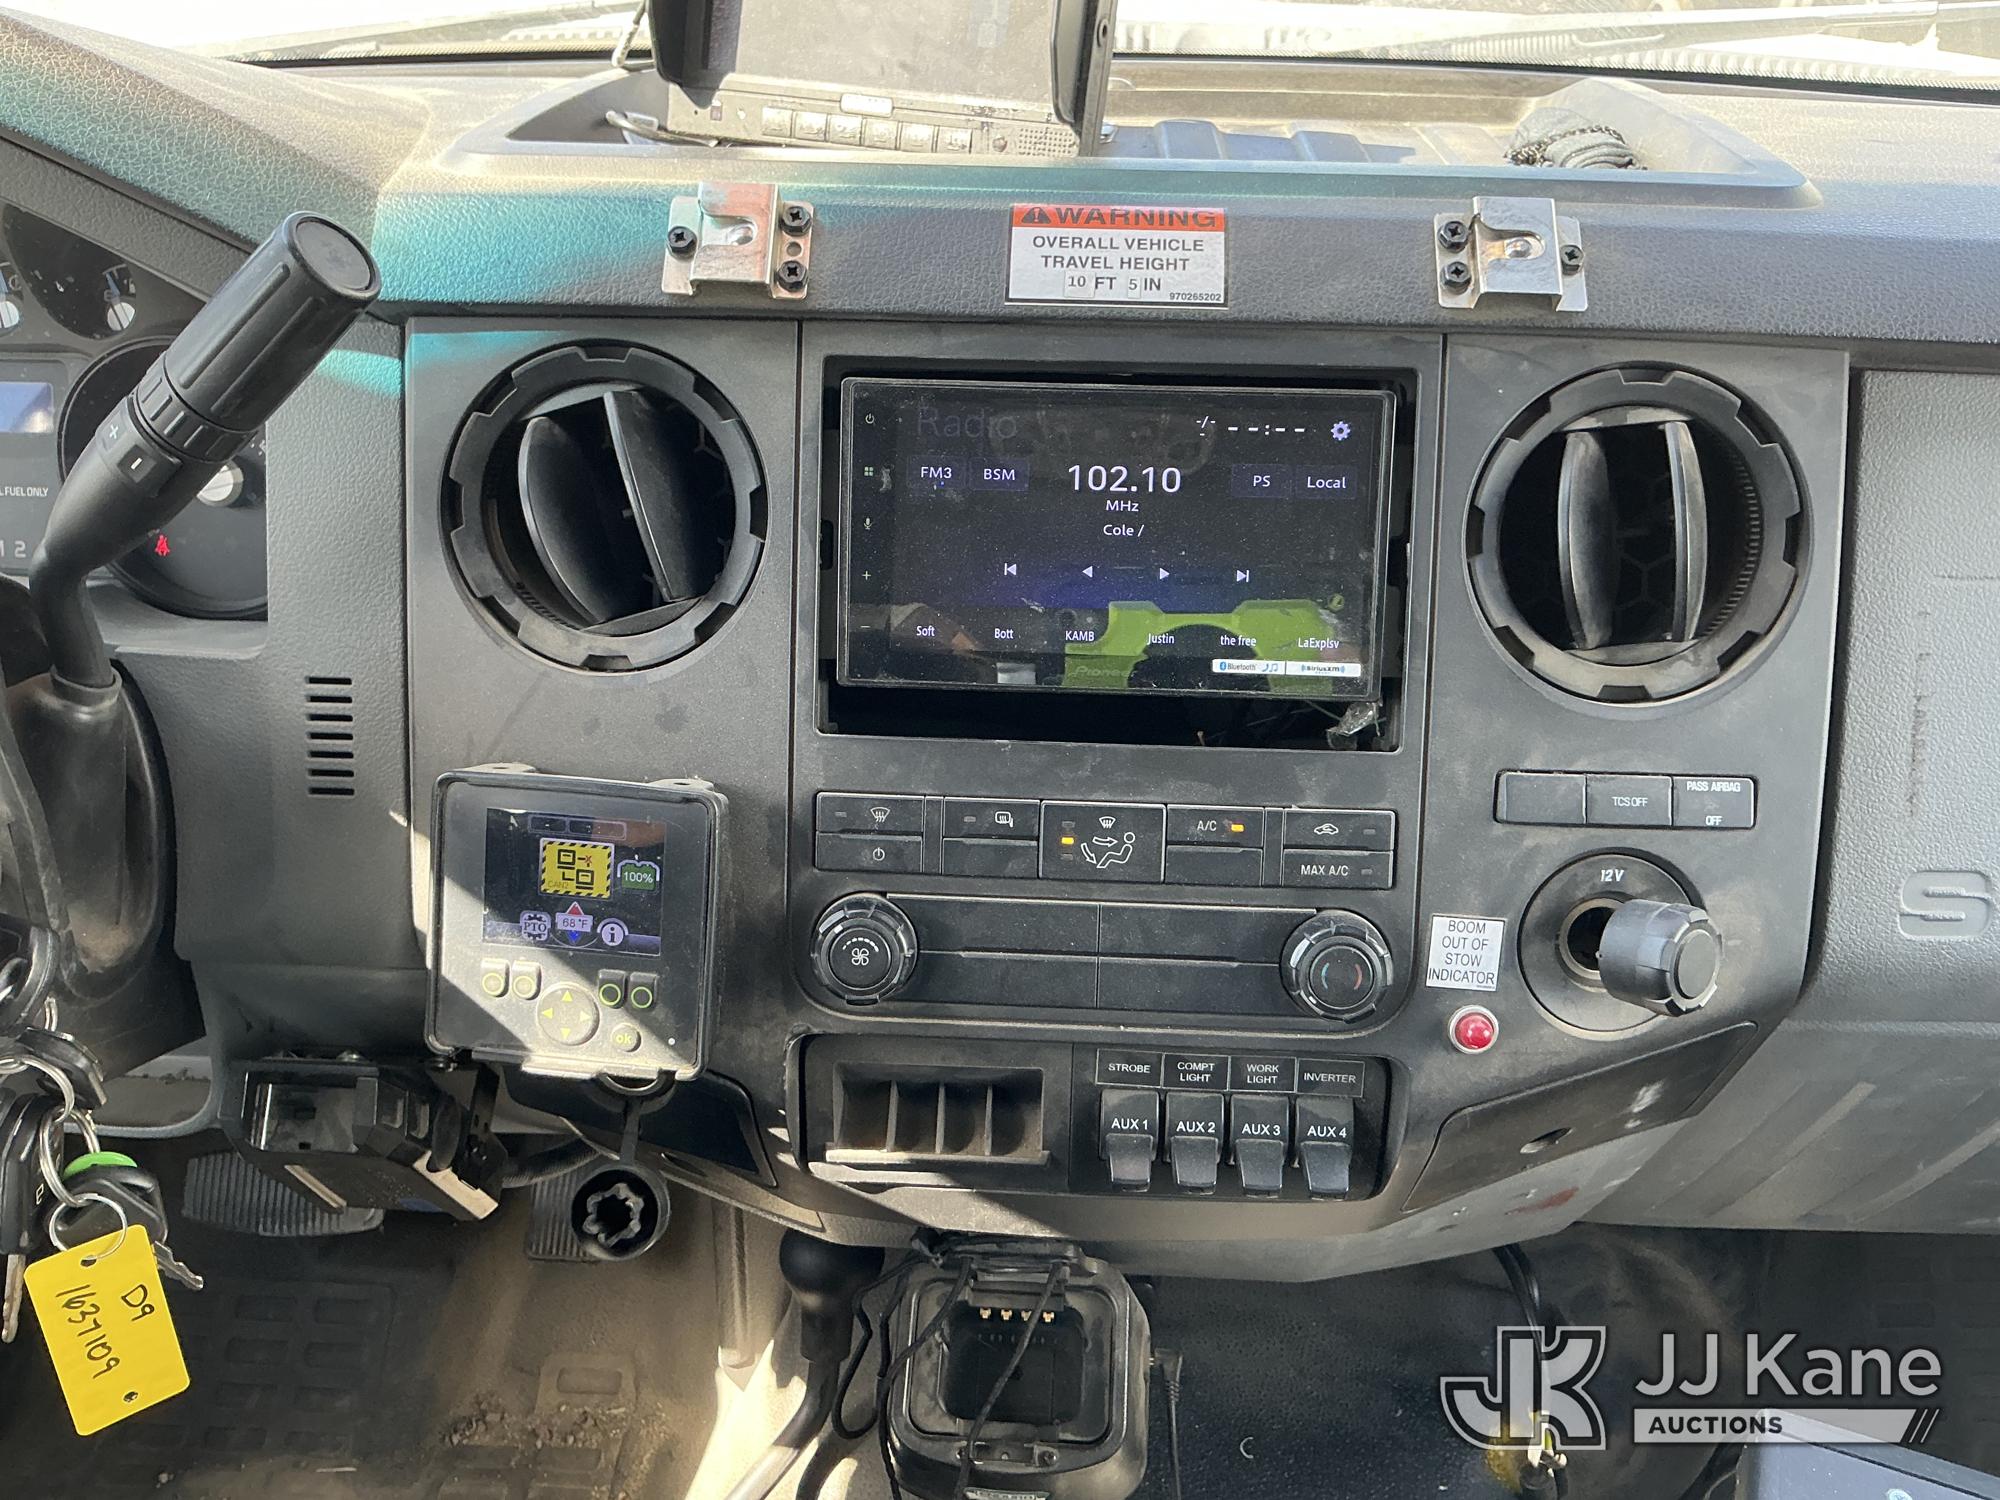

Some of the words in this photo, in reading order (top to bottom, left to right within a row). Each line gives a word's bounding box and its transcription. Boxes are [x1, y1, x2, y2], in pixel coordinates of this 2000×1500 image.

[1055, 207, 1216, 228] WARNING
[1033, 235, 1119, 250] OVERALL
[1125, 238, 1204, 252] VEHICLE
[1041, 255, 1114, 269] TRAVEL
[1120, 257, 1190, 271] HEIGHT
[1068, 275, 1086, 288] 10
[1094, 277, 1117, 290] FT
[1128, 278, 1138, 290] 5
[1143, 278, 1161, 290] IN
[1169, 293, 1222, 302] 970265202
[921, 467, 952, 479] FM3
[983, 469, 1016, 481] BSM
[1068, 465, 1181, 493] 102.10
[1253, 475, 1271, 488] PS
[1307, 476, 1346, 489] Local
[4, 486, 26, 497] FUEL
[27, 487, 49, 497] ONLY
[1105, 500, 1139, 512] MHz
[1103, 525, 1135, 537] Cole
[916, 625, 935, 637] Soft
[994, 628, 1014, 639] Bott
[1065, 630, 1095, 642] KAMB
[1146, 633, 1175, 645] Justin
[1220, 635, 1236, 646] the
[1237, 636, 1257, 647] free
[1298, 637, 1340, 651] LaExplsv
[1227, 662, 1256, 671] Bluetooth
[1686, 781, 1709, 792] PASS
[1710, 782, 1741, 793] AIRBAG
[1612, 796, 1630, 807] TCS
[1631, 797, 1648, 807] OFF
[1197, 820, 1217, 832] A/C
[1706, 815, 1723, 826] OFF
[1301, 865, 1326, 876] MAX
[1328, 865, 1349, 877] A/C
[624, 872, 654, 884] 100%
[524, 922, 546, 932] PTO
[562, 918, 576, 928] 68
[1448, 920, 1486, 934] BOOM
[1442, 936, 1468, 949] OUT
[1471, 938, 1489, 951] OF
[1445, 953, 1482, 967] STOW
[1428, 968, 1495, 985] INDICATOR
[616, 1032, 632, 1043] ok
[1108, 1063, 1151, 1074] STROBE
[1177, 1062, 1215, 1071] COMPT
[1246, 1064, 1279, 1073] WORK
[1180, 1073, 1211, 1082] LIGHT
[1247, 1075, 1278, 1084] LIGHT
[1303, 1072, 1357, 1083] INVERTER
[1111, 1118, 1140, 1130] AUX
[1142, 1119, 1148, 1130] 1
[1176, 1121, 1205, 1132] AUX
[1207, 1122, 1216, 1133] 2
[1241, 1123, 1270, 1135] AUX
[1273, 1125, 1281, 1136] 3
[1307, 1126, 1336, 1138] AUX
[1339, 1127, 1347, 1138] 4
[121, 1284, 155, 1322] D9
[55, 1284, 120, 1380] 1637109
